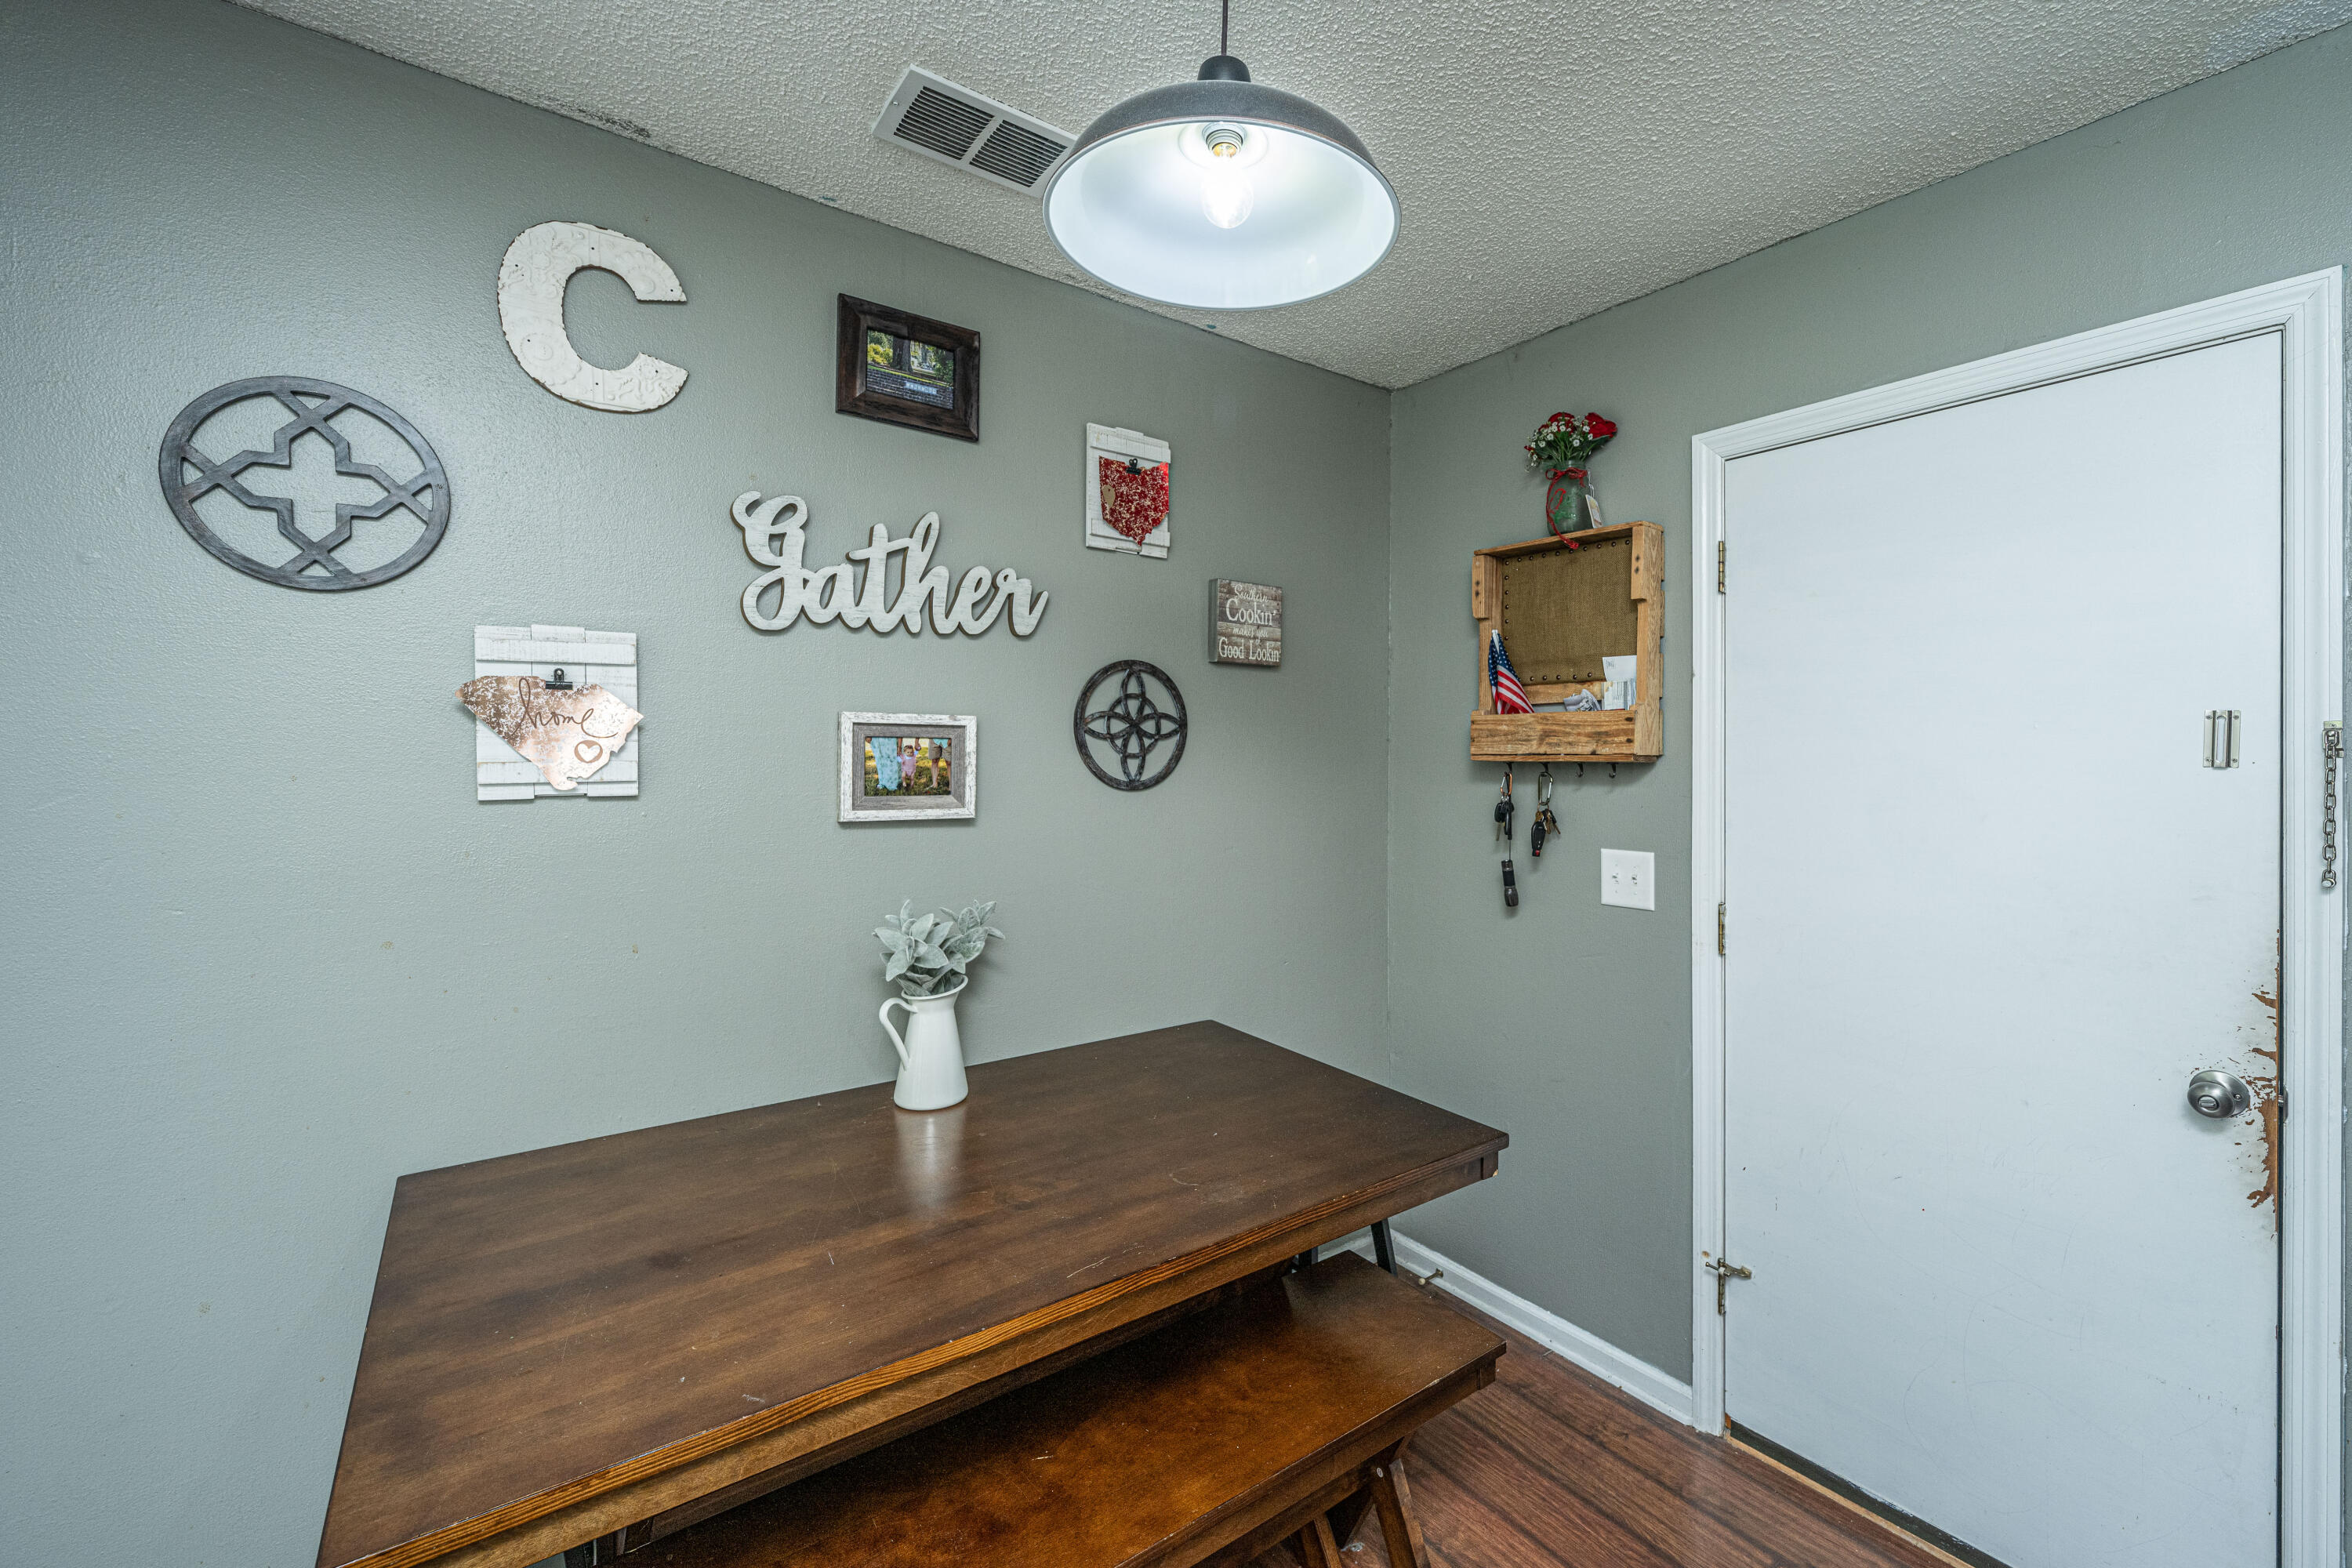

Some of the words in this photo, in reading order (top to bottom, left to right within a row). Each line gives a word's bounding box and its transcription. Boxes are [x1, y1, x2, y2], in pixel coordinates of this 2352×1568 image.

[497, 220, 688, 414] C
[730, 490, 1049, 637] Gather
[1234, 584, 1268, 603] Southern
[1226, 598, 1276, 626] Cookin'
[1219, 637, 1245, 659] Good
[1233, 627, 1254, 637] makes
[1256, 629, 1269, 644] you
[510, 677, 619, 739] home
